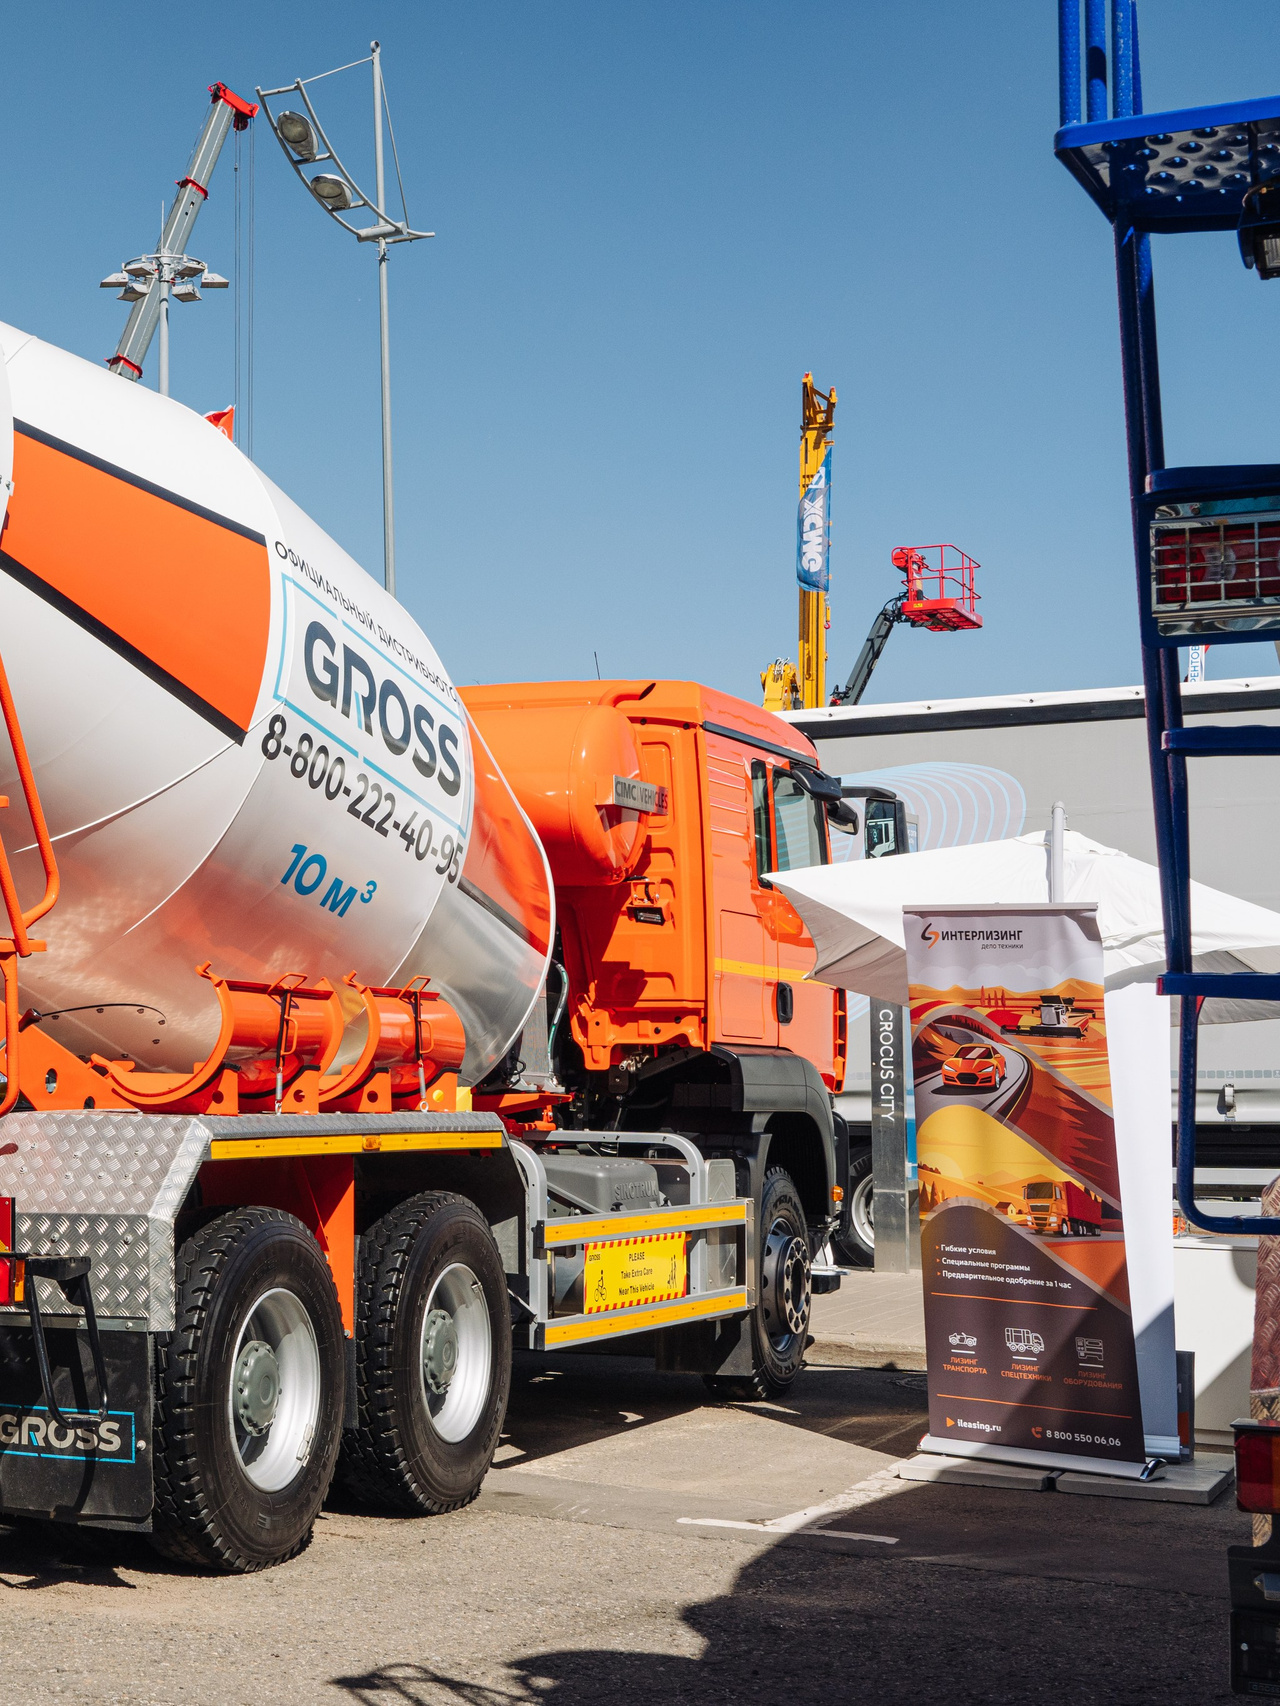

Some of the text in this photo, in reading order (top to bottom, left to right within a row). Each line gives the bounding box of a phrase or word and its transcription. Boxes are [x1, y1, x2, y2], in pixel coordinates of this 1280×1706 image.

[802, 495, 823, 572] XCMG
[275, 540, 457, 703] ОФИЦИАЛЬНЫЙ ДИСТРИБЬЮТО
[304, 620, 463, 797] GROSS
[261, 714, 464, 884] 8-800-222-40-95
[615, 780, 669, 810] CIMC VEHICLES
[280, 844, 328, 896] 10
[941, 930, 1023, 941] ИНТЕРЛИЗИНГ
[879, 1009, 895, 1122] CROCUS CITY
[614, 1180, 658, 1201] SINOTRUK
[941, 1244, 997, 1255] Гибкие условия
[629, 1252, 645, 1262] PLEASE
[941, 1258, 1031, 1272] Специальные программы
[621, 1267, 653, 1279] Take Extra Care
[942, 1270, 1005, 1284] Предварительное
[1005, 1276, 1044, 1287] одобрение
[1058, 1281, 1072, 1289] час
[619, 1283, 655, 1296] Near This Vehicle
[950, 1356, 978, 1365] ЛИЗИНГ
[942, 1364, 988, 1375] ТРАНСПОРТА
[1011, 1363, 1040, 1372] ЛИЗИНГ
[1001, 1371, 1052, 1382] СПЕЦТЕХНИКИ
[1078, 1370, 1107, 1379] ЛИЗИНГ
[1063, 1377, 1123, 1390] ОБОРУДОВАНИЯ
[957, 1418, 1002, 1432] ileasing.ru
[1046, 1430, 1053, 1438] 8
[1053, 1431, 1073, 1441] 800
[1074, 1433, 1093, 1443] 550
